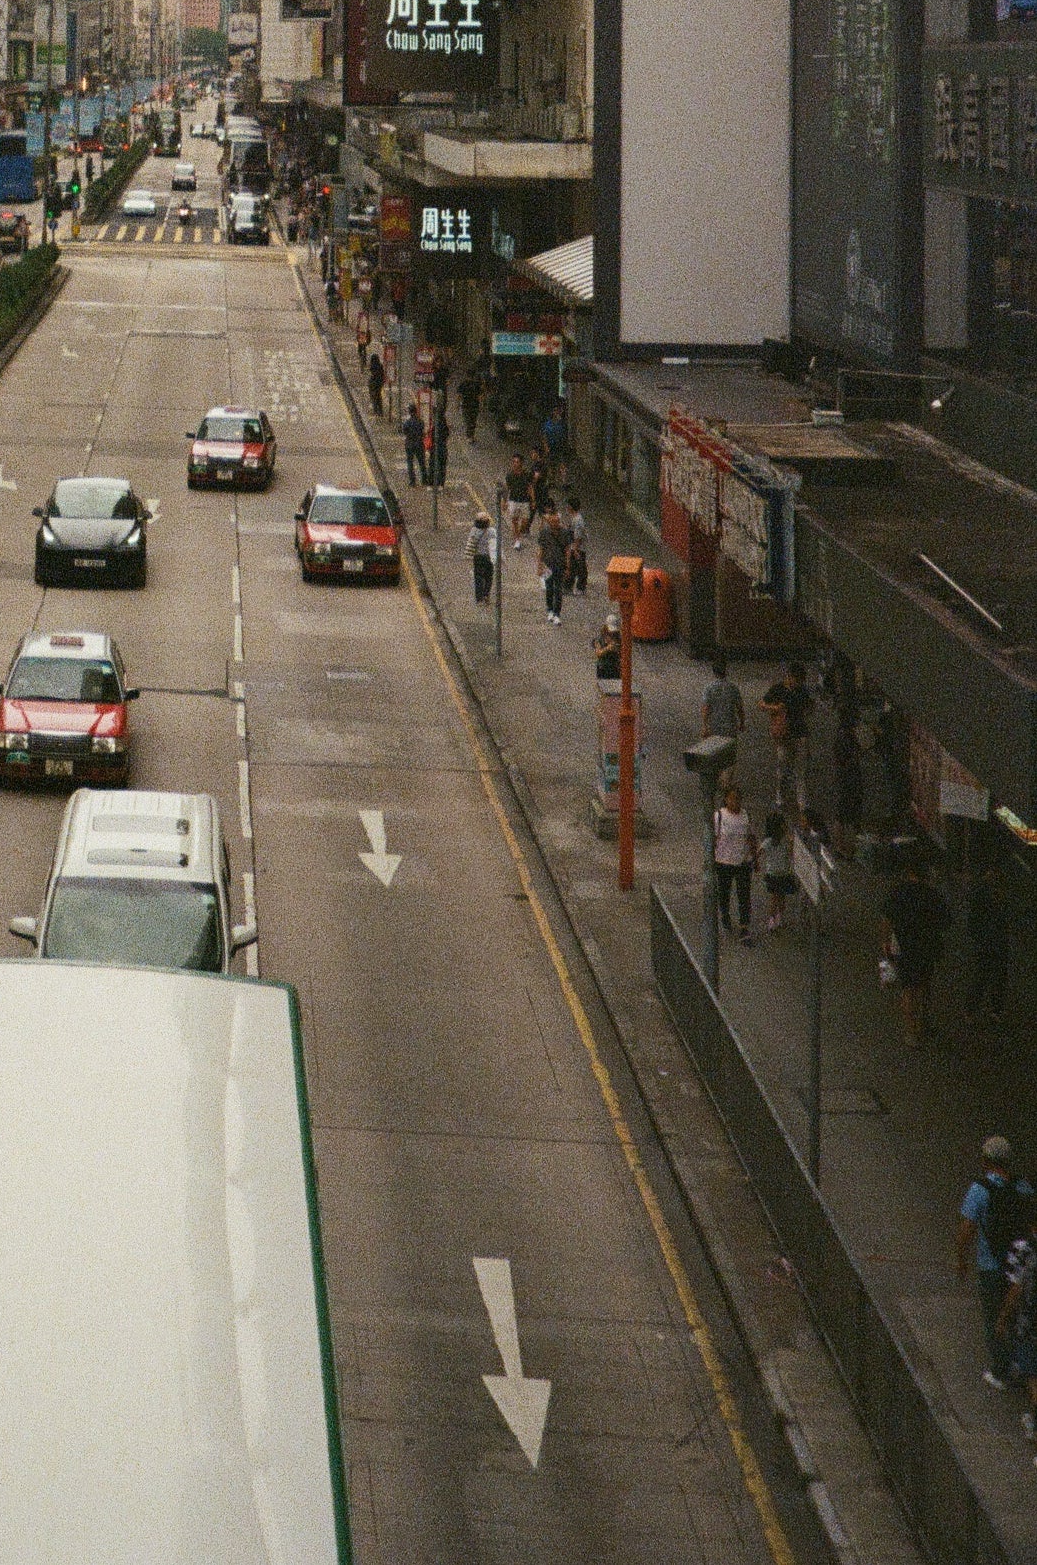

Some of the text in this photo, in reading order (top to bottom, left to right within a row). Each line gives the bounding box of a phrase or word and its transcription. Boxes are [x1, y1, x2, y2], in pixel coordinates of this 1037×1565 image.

[386, 29, 483, 55] Chow Sang Sang
[421, 208, 471, 239] 周生生
